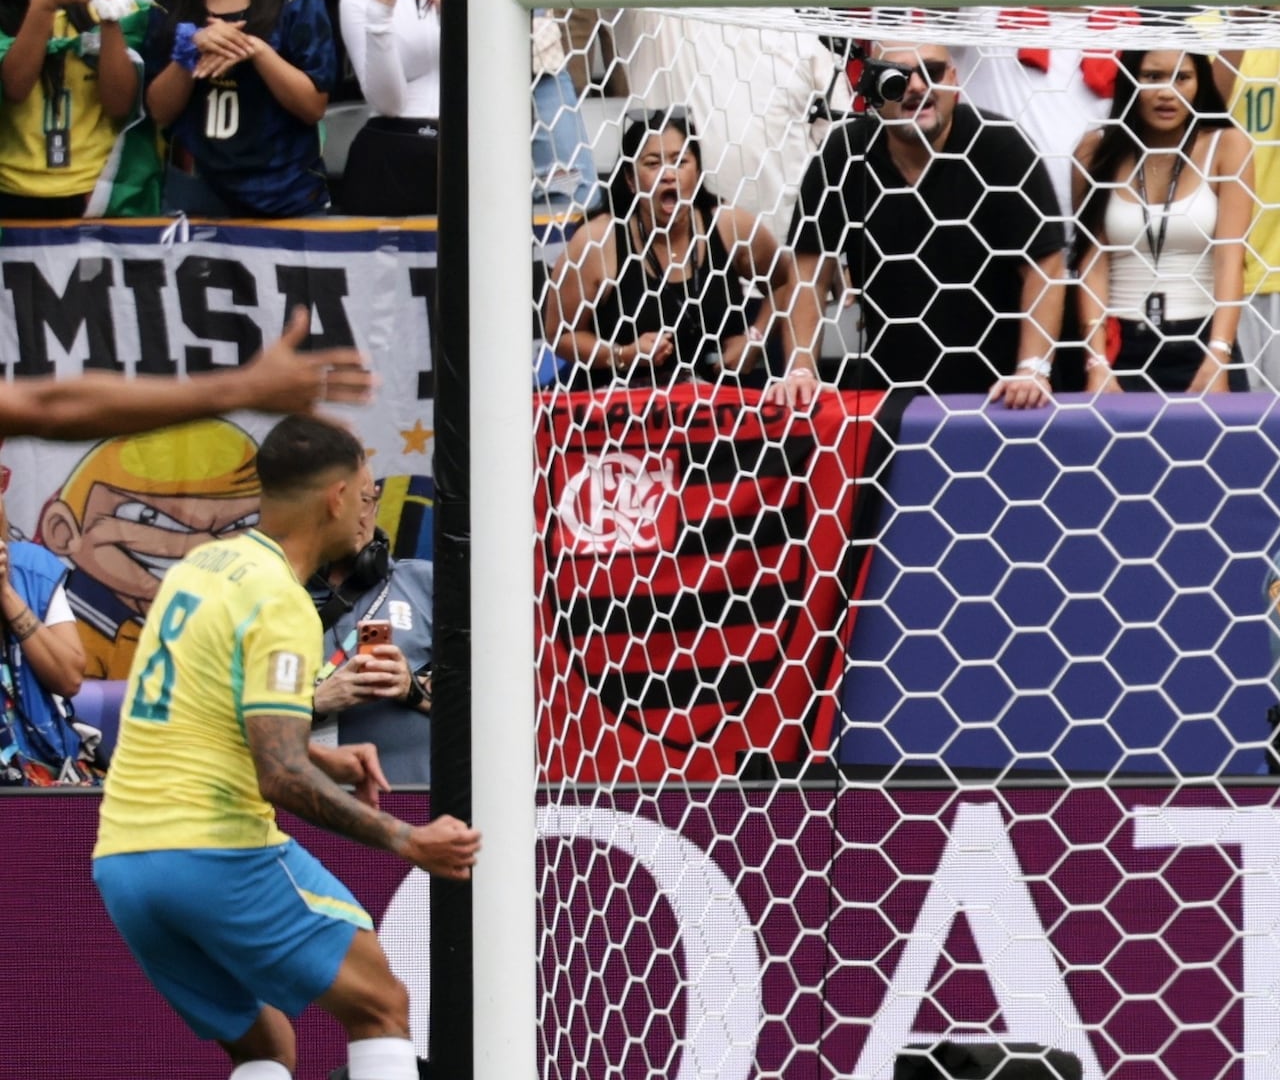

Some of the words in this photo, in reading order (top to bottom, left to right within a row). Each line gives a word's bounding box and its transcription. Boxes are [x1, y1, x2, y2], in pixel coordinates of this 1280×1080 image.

[206, 88, 240, 140] 10
[1245, 86, 1275, 133] 10
[0, 256, 361, 378] MISA
[129, 591, 203, 723] 8
